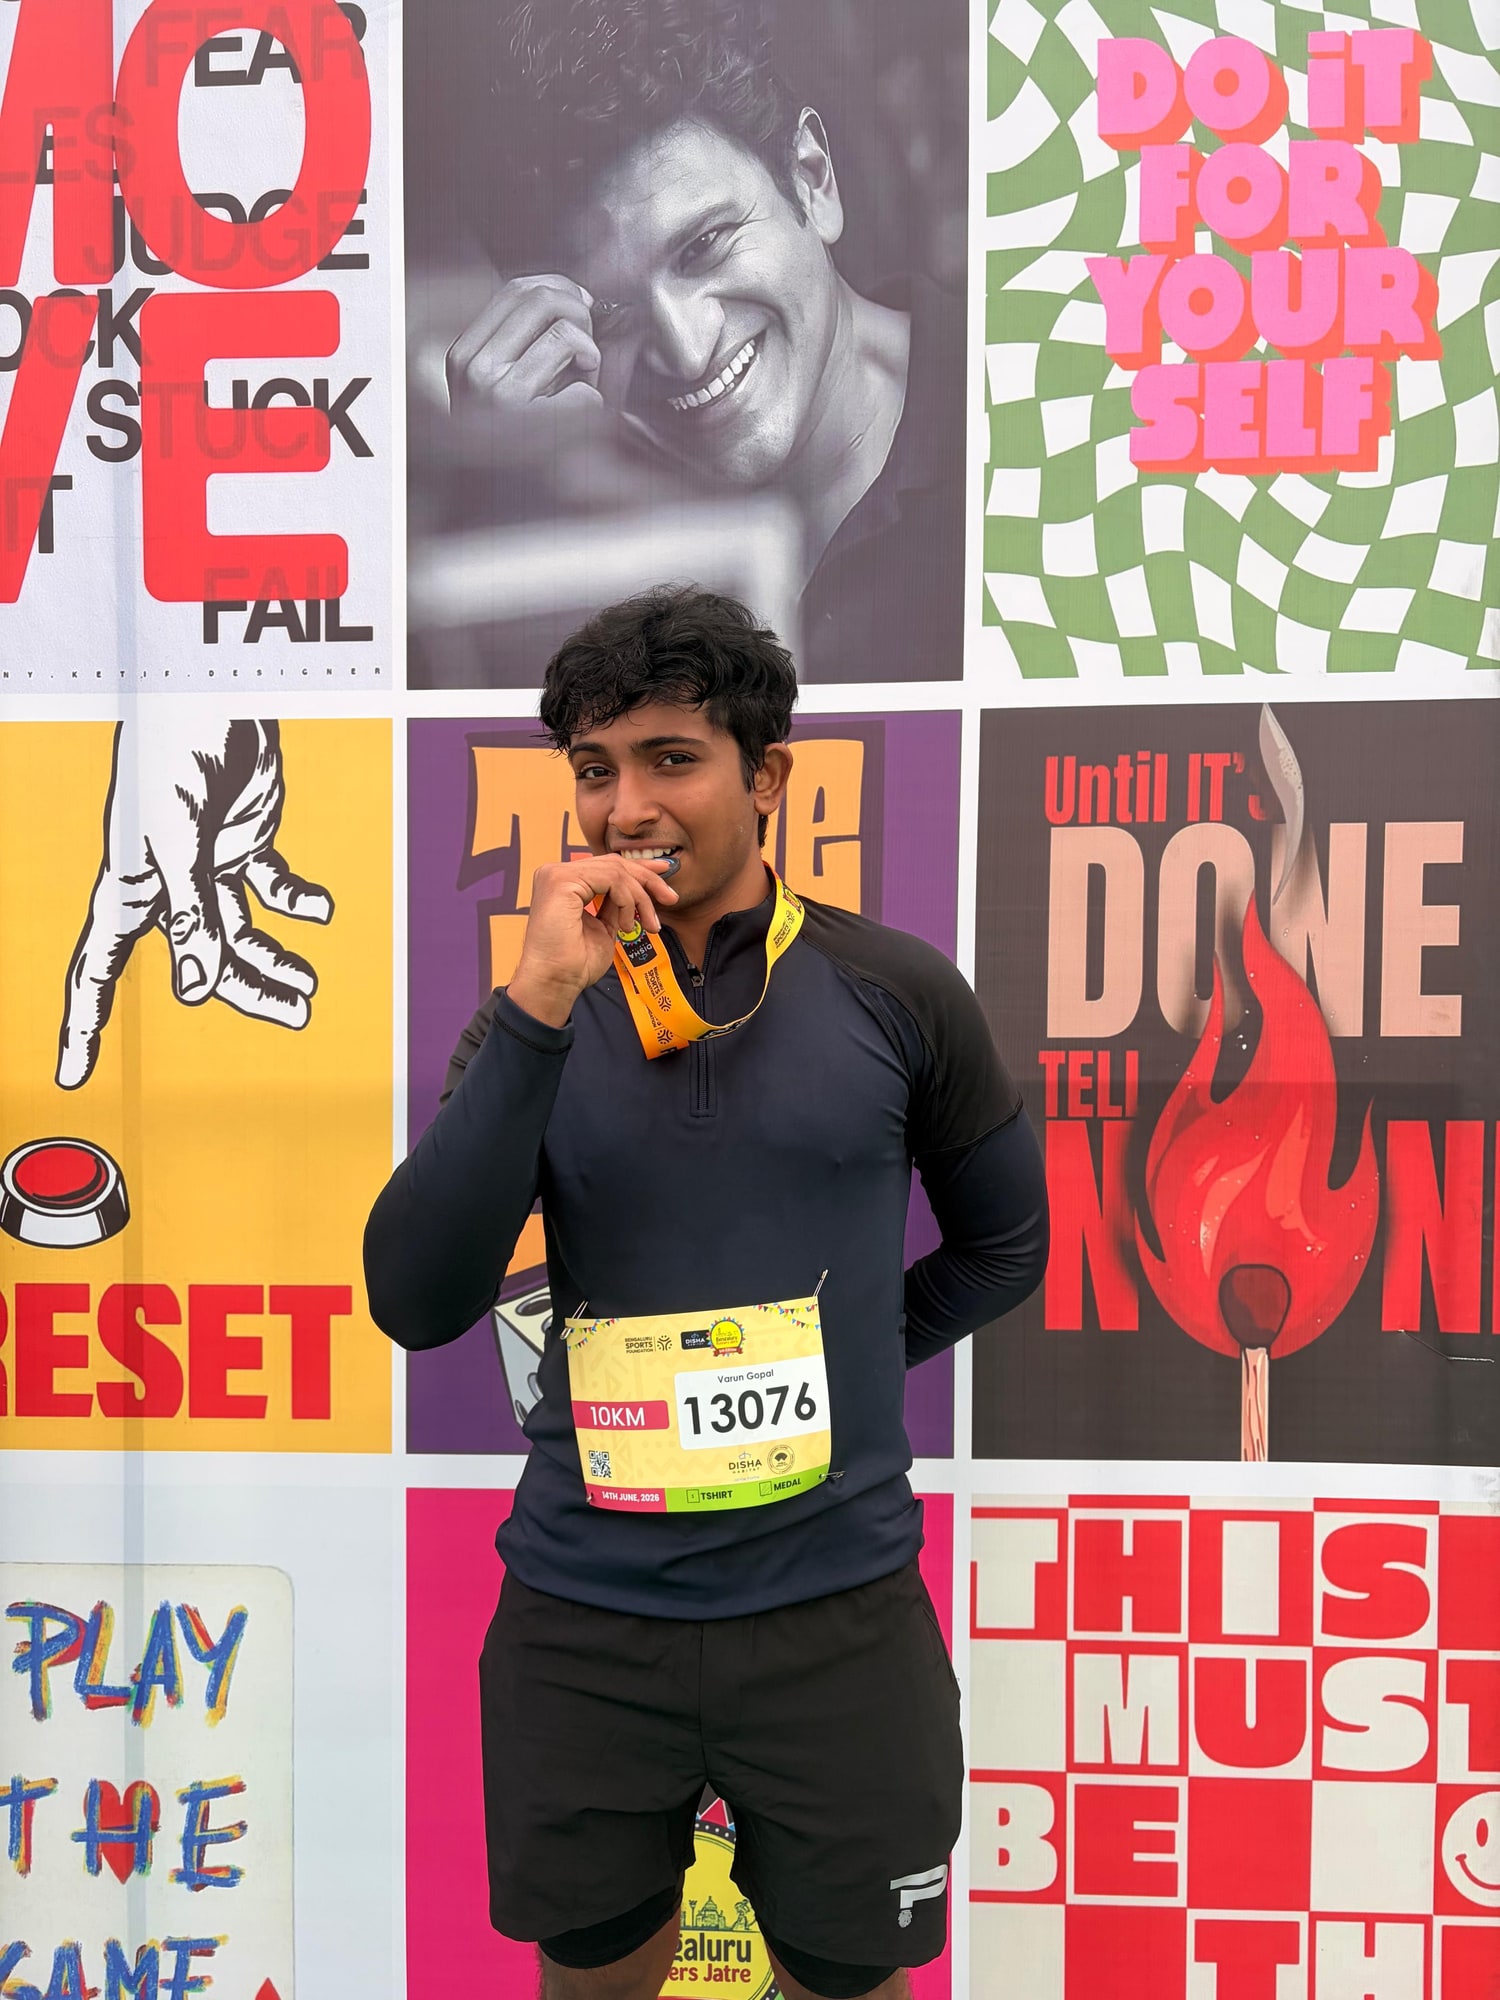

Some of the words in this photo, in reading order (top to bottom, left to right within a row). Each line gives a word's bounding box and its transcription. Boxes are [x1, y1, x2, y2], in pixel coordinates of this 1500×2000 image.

[1098, 37, 1285, 146] DO
[83, 189, 370, 276] JUDGE
[1140, 140, 1386, 252] FOR
[1084, 246, 1440, 368] YOUR
[86, 377, 374, 463] STUCK
[1129, 357, 1391, 473] SELF
[202, 566, 373, 644] FAIL
[1045, 751, 1168, 824] Until
[1046, 822, 1464, 1038] DONE
[648, 970, 661, 995] SPORTS
[0, 1283, 352, 1419] ESET
[717, 1374, 744, 1383] Varun
[746, 1369, 774, 1380] Gopal
[590, 1406, 645, 1427] 10KM
[684, 1382, 816, 1435] 13076
[601, 1491, 619, 1500] 14TH
[619, 1492, 640, 1502] JUNE,
[640, 1493, 660, 1502] 2026
[700, 1490, 733, 1500] TSHIRT
[728, 1459, 762, 1471] DISHA
[773, 1478, 801, 1491] MEDAL
[970, 1518, 1431, 1640] THIS
[6, 1600, 249, 1727] PLAY
[0, 1774, 248, 1891] THE
[969, 1782, 1180, 1898] BE
[703, 1963, 751, 1983] Jatre
